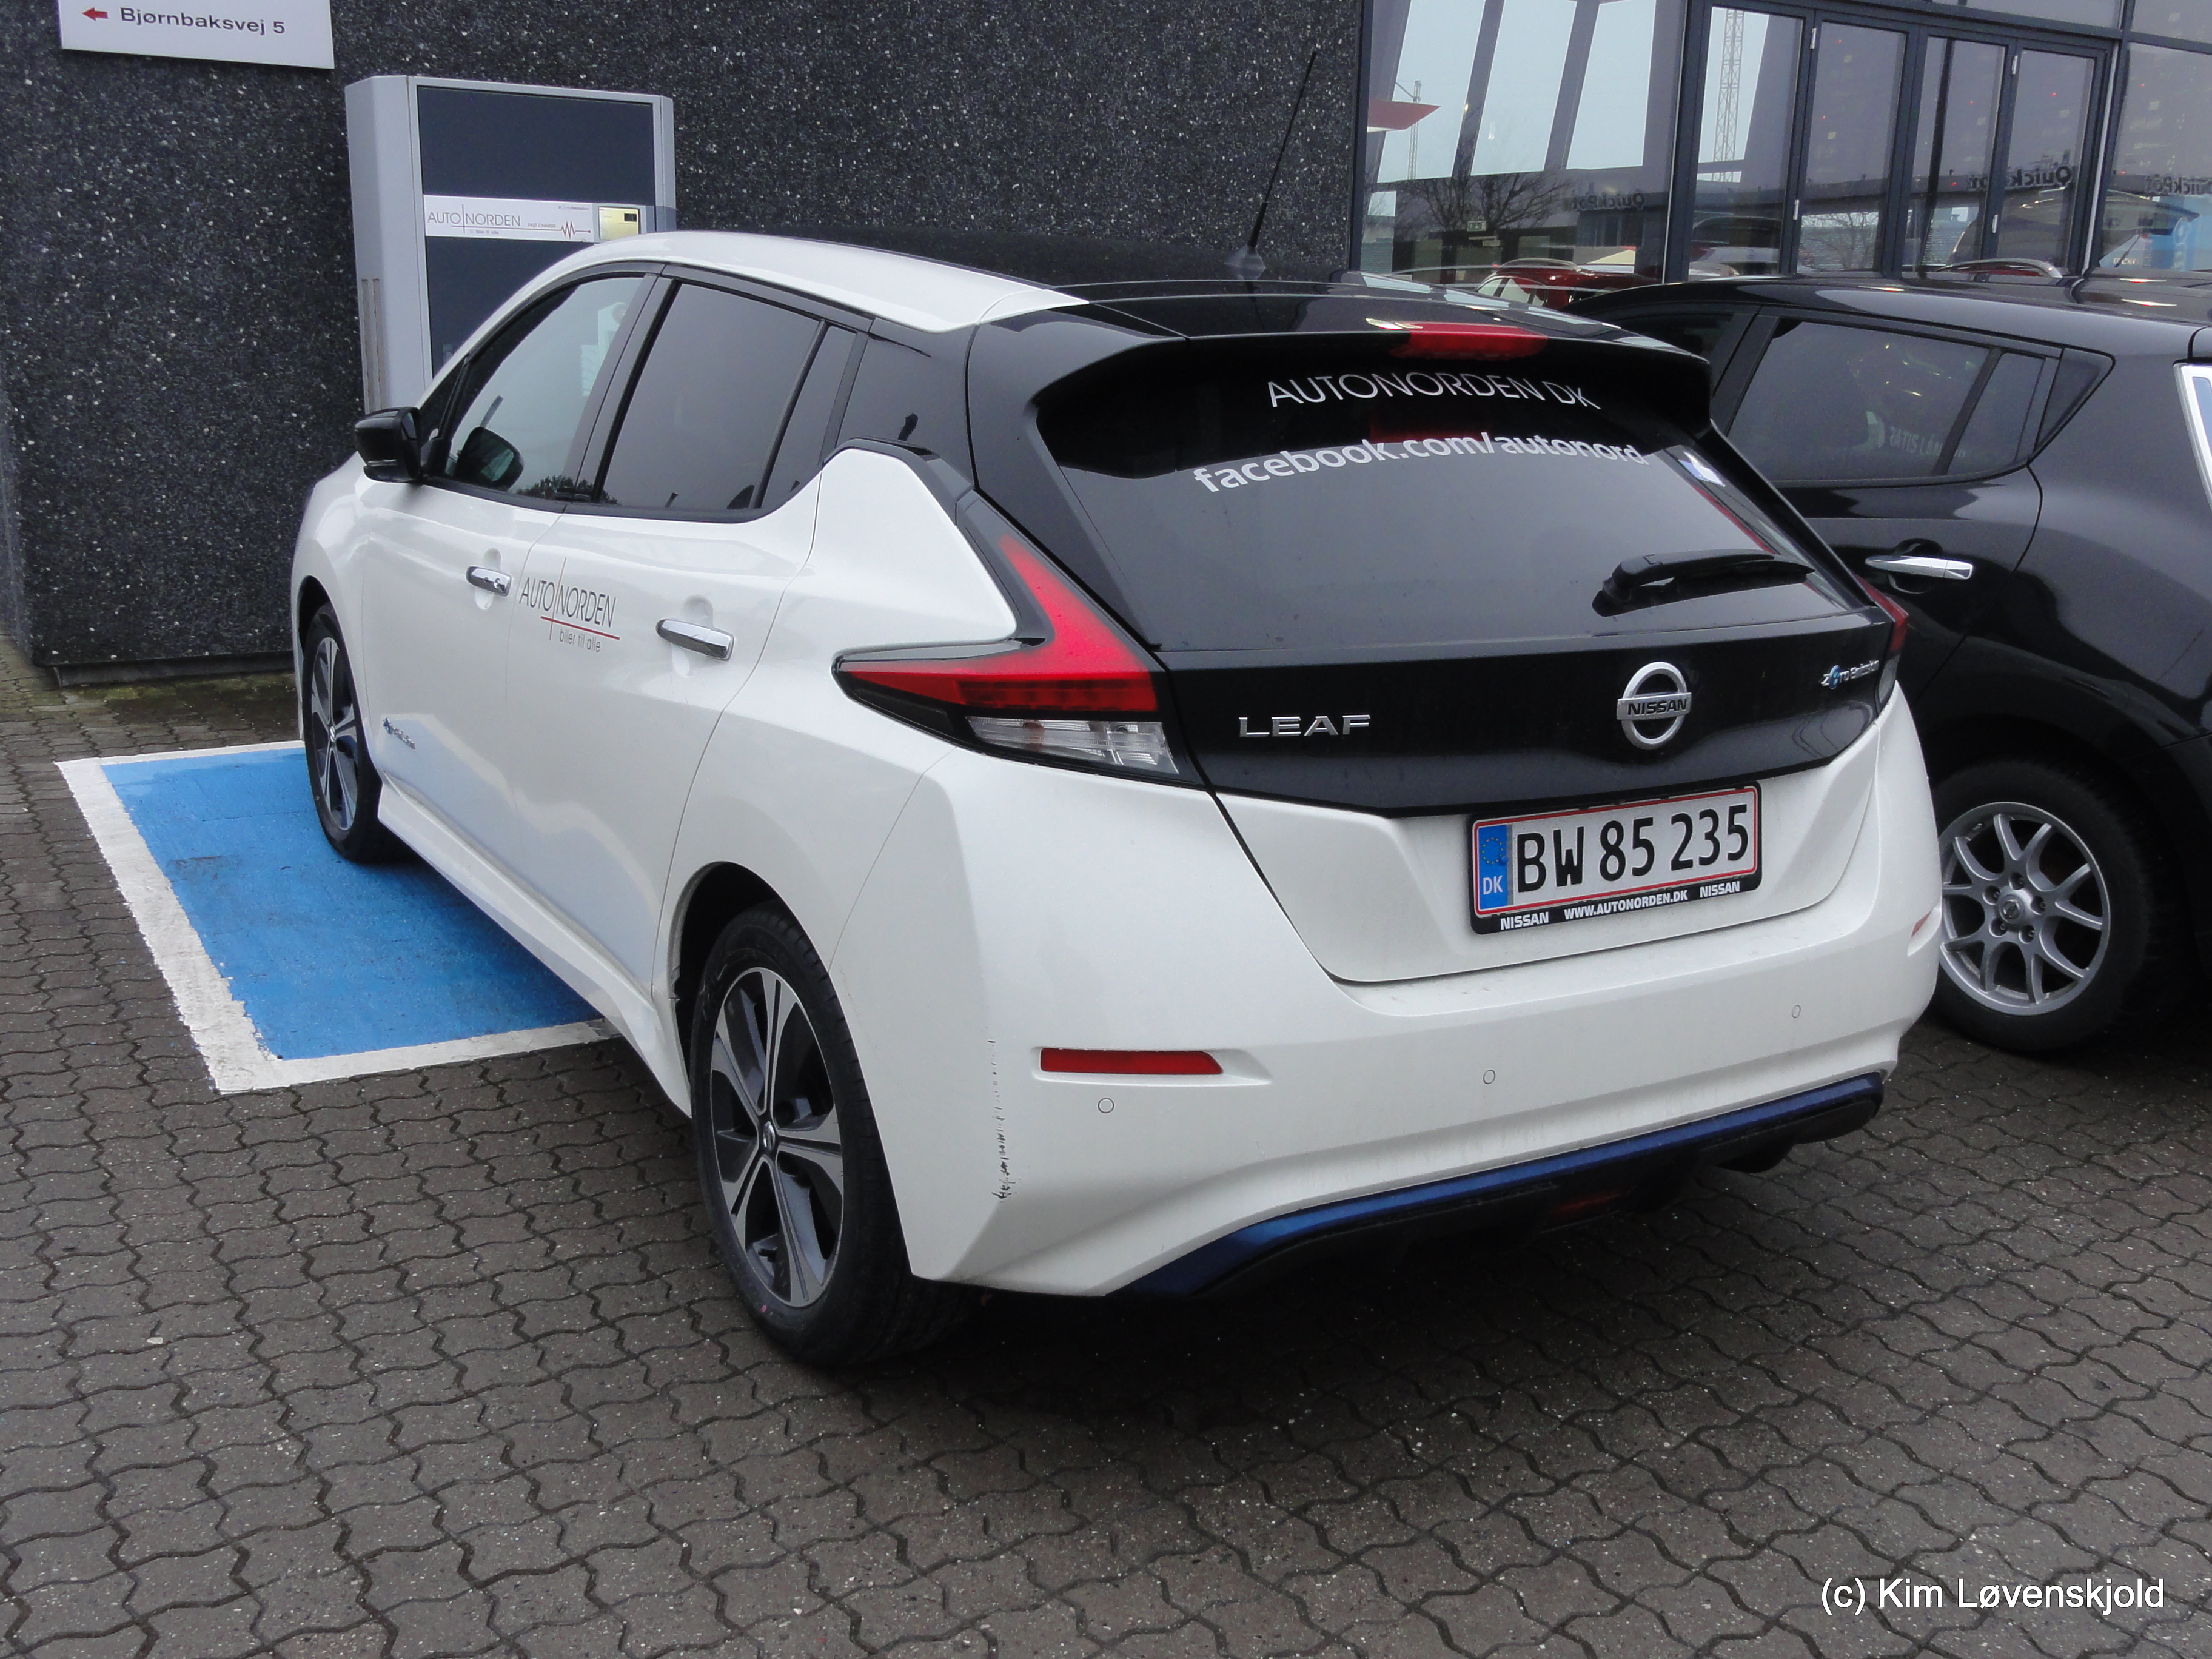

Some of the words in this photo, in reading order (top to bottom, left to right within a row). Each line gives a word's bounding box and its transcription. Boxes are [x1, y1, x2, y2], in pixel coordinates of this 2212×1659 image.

[120, 7, 266, 36] Bjørnbaksvej
[272, 21, 286, 35] 5
[1267, 372, 1546, 408] AUTONORDEN
[1541, 380, 1601, 410] DK
[1193, 432, 1650, 492] facebook.com/autonord
[559, 628, 576, 645] biler
[577, 634, 586, 649] til
[586, 637, 602, 653] alle
[1627, 698, 1687, 716] NISSAN
[1238, 714, 1371, 738] LEAF
[1517, 826, 1584, 893] BW
[1599, 816, 1655, 882] 85
[1670, 803, 1749, 871] 235
[1483, 875, 1503, 896] DK
[1500, 911, 1549, 931] NISSAN
[1564, 889, 1689, 920] WWW.AUTONORDEN.DK
[1699, 880, 1741, 899] NISSAN
